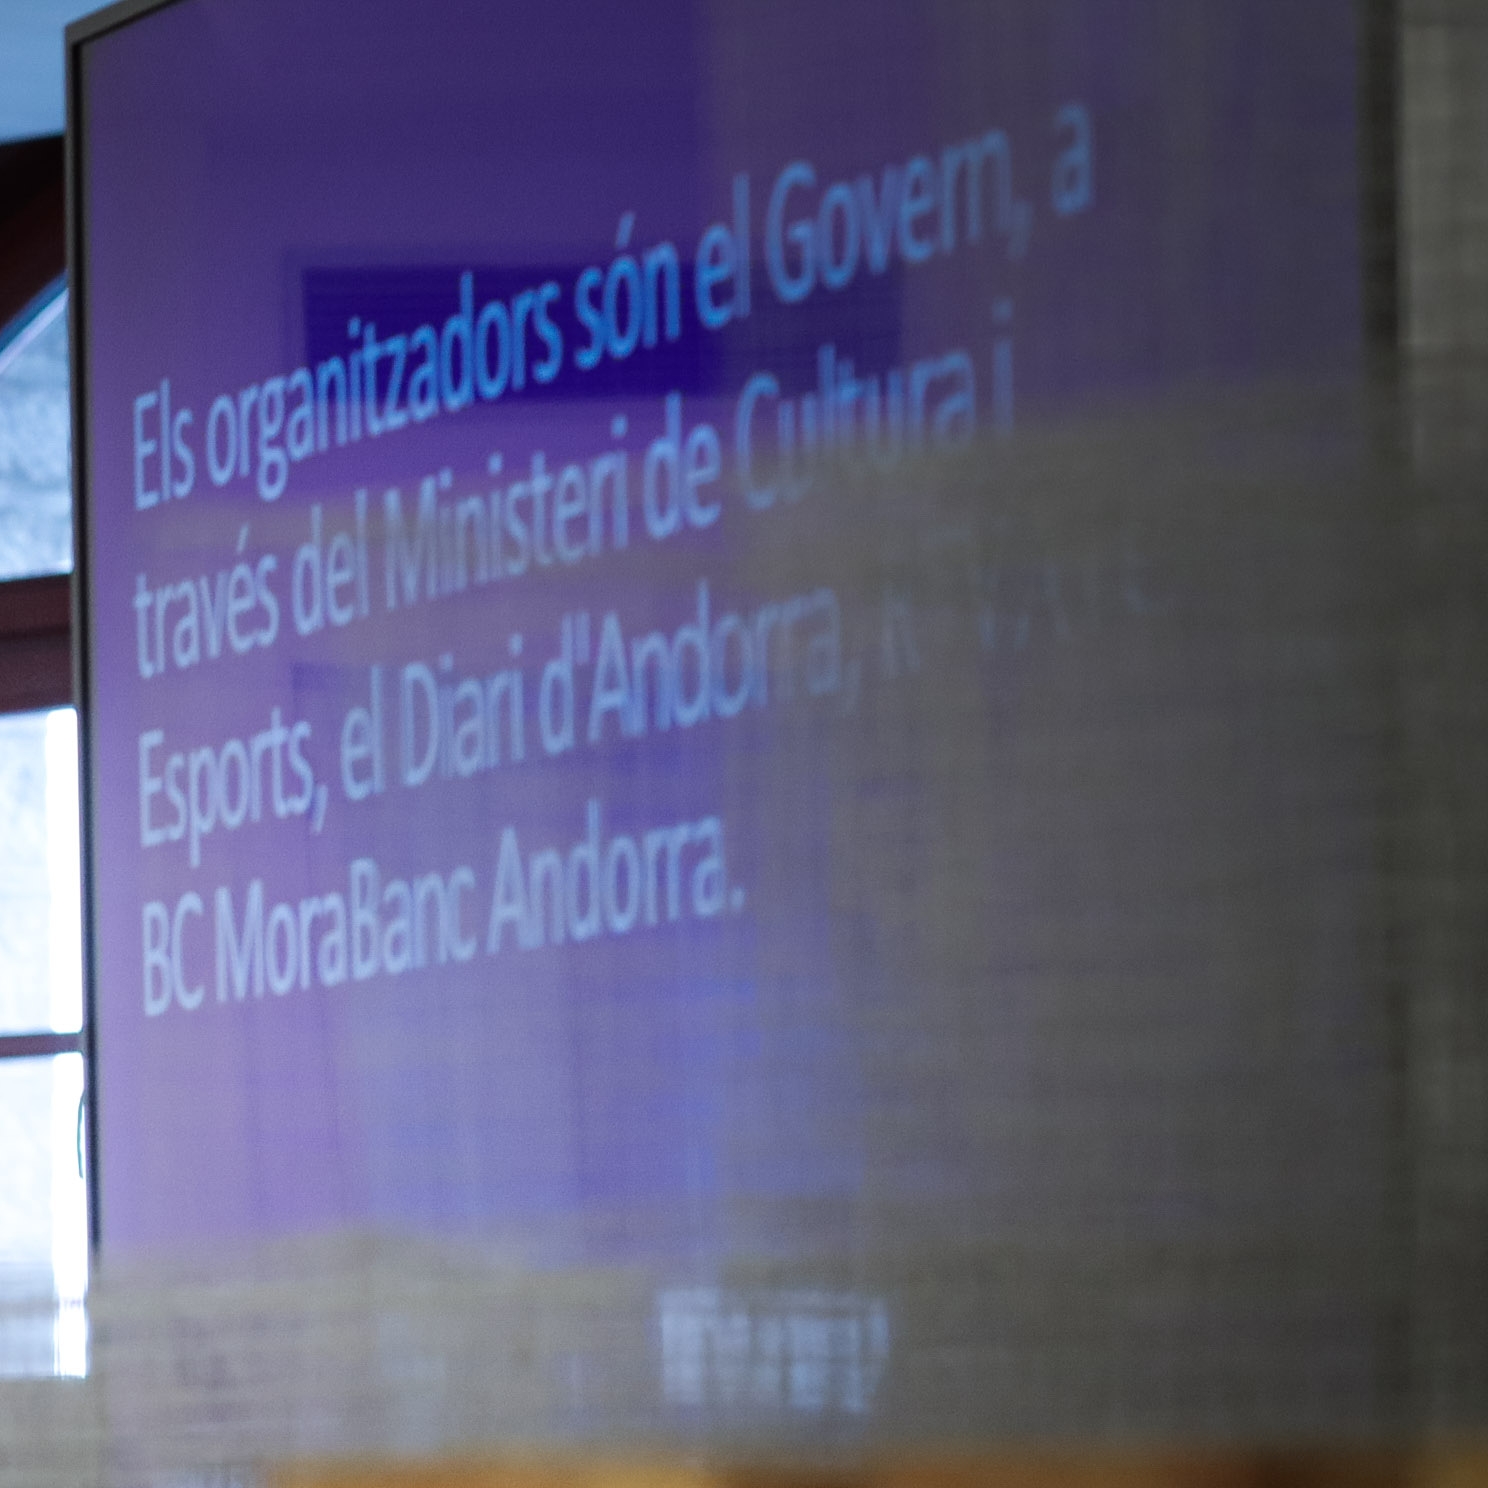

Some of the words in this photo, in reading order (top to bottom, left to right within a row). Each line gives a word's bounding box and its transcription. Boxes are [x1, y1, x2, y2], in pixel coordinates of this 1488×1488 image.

[133, 378, 195, 512] Els
[205, 270, 566, 502] organitzadors
[572, 212, 682, 370] són
[695, 172, 751, 330] el
[1049, 102, 1094, 218] a
[136, 522, 280, 680] través
[292, 487, 370, 636] del
[384, 415, 629, 614] Ministeri
[644, 392, 723, 540] de
[736, 342, 976, 510] Cultura
[992, 297, 1015, 442] i
[137, 706, 327, 868] Esports,
[340, 663, 386, 801] el
[402, 632, 525, 789] Diari
[142, 892, 205, 1018] BC
[215, 858, 477, 1003] MoraBanc
[487, 798, 746, 955] Andorra.
